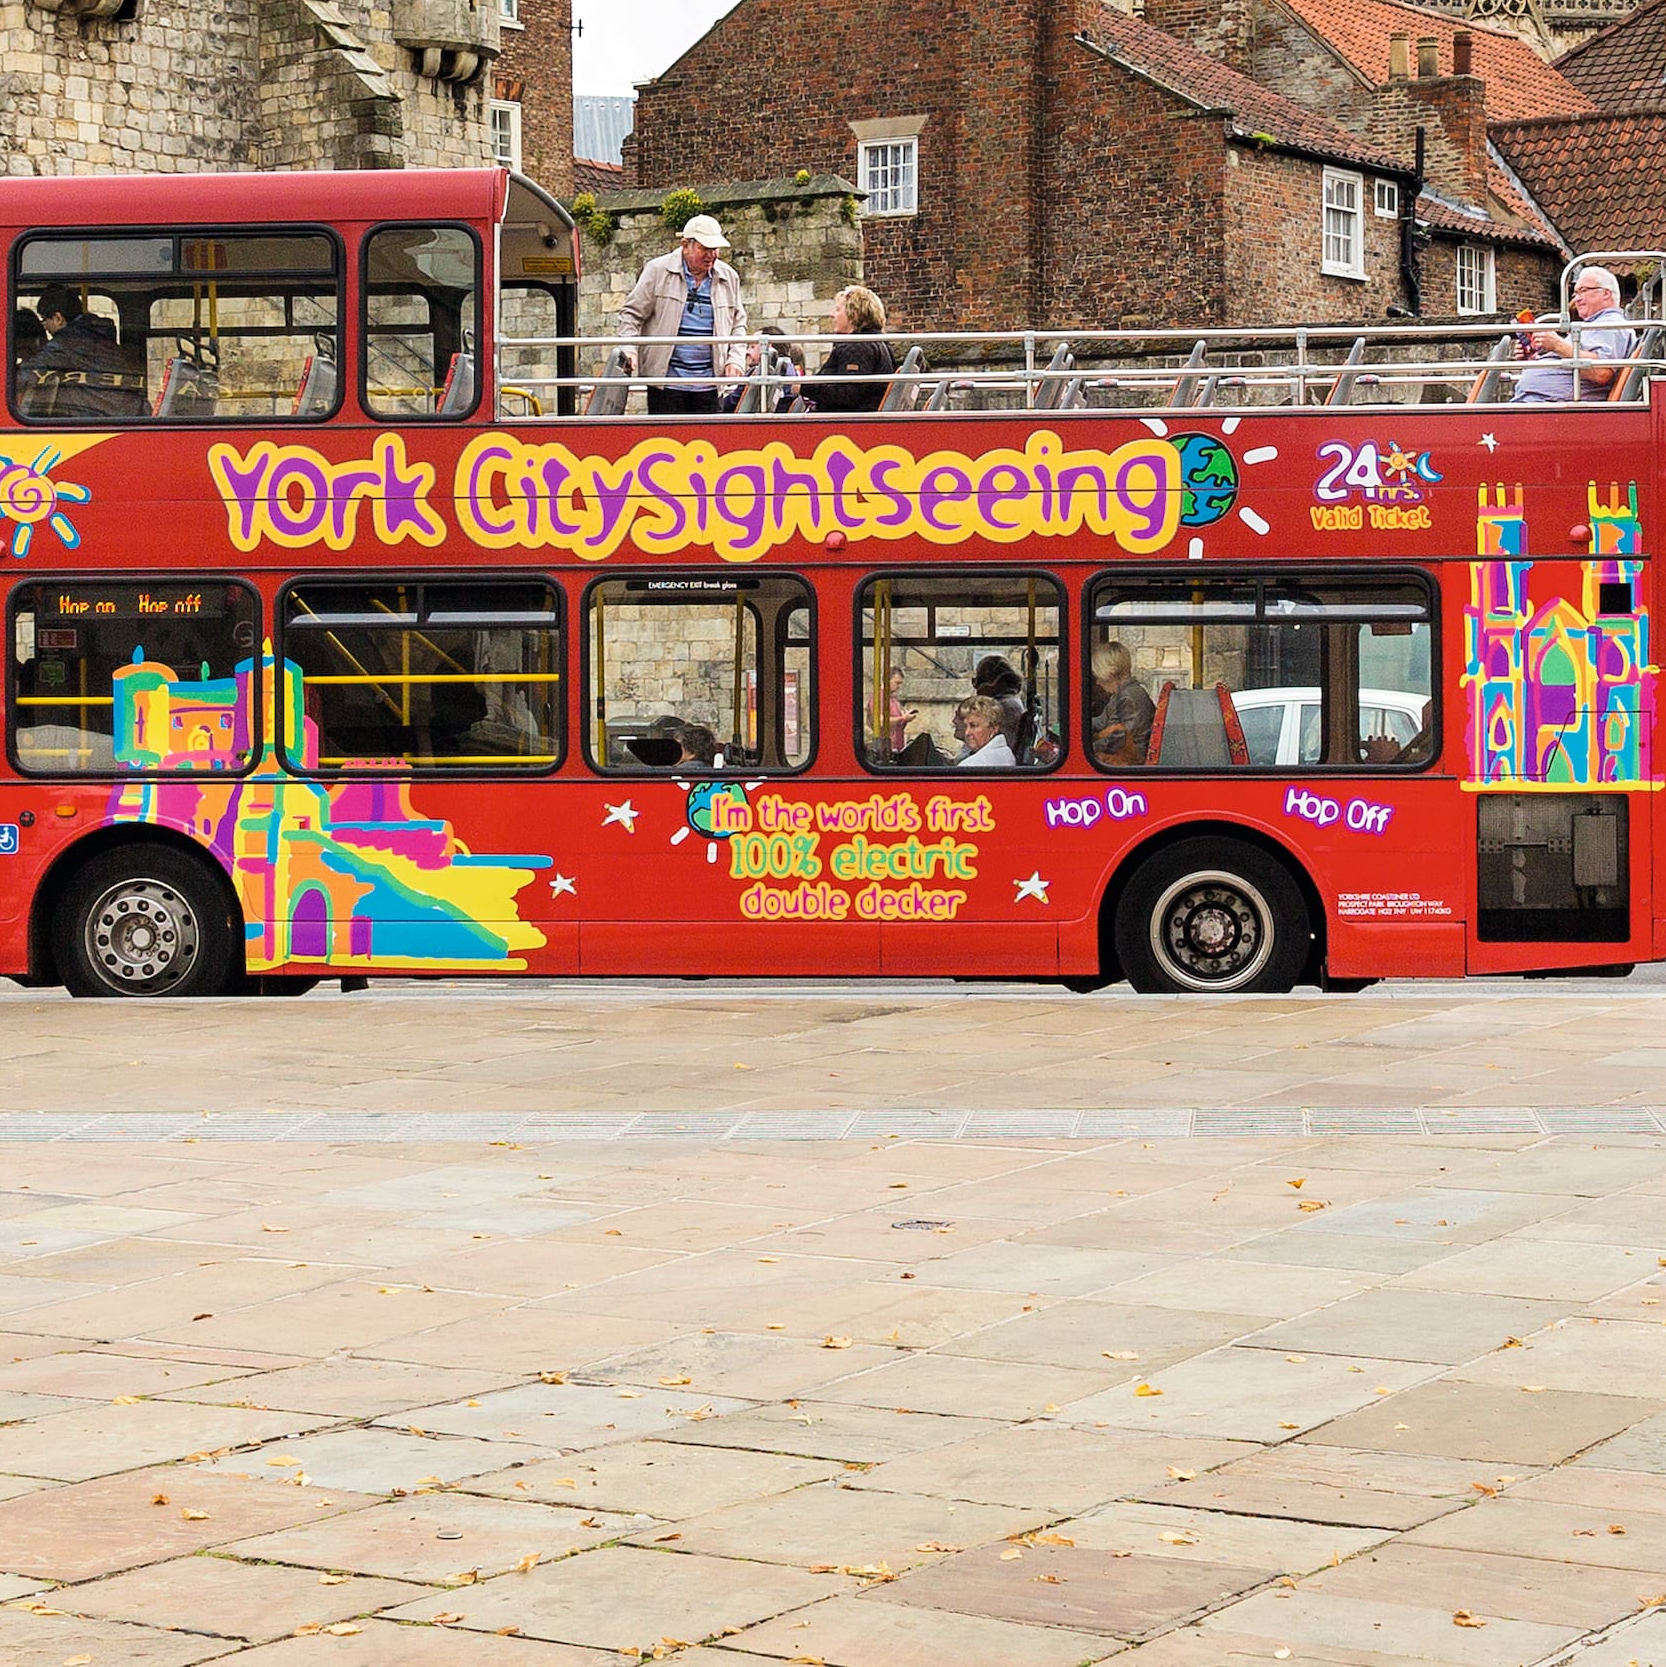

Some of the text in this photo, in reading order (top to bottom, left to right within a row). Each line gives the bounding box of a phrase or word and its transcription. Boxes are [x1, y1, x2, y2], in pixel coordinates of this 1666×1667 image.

[1311, 505, 1432, 530] Valid Ticket
[712, 796, 992, 830] I'm the world's first
[1046, 788, 1146, 826] Hop On
[1284, 787, 1393, 832] Hop Off
[732, 834, 976, 877] 100% electric
[742, 884, 964, 917] double decker
